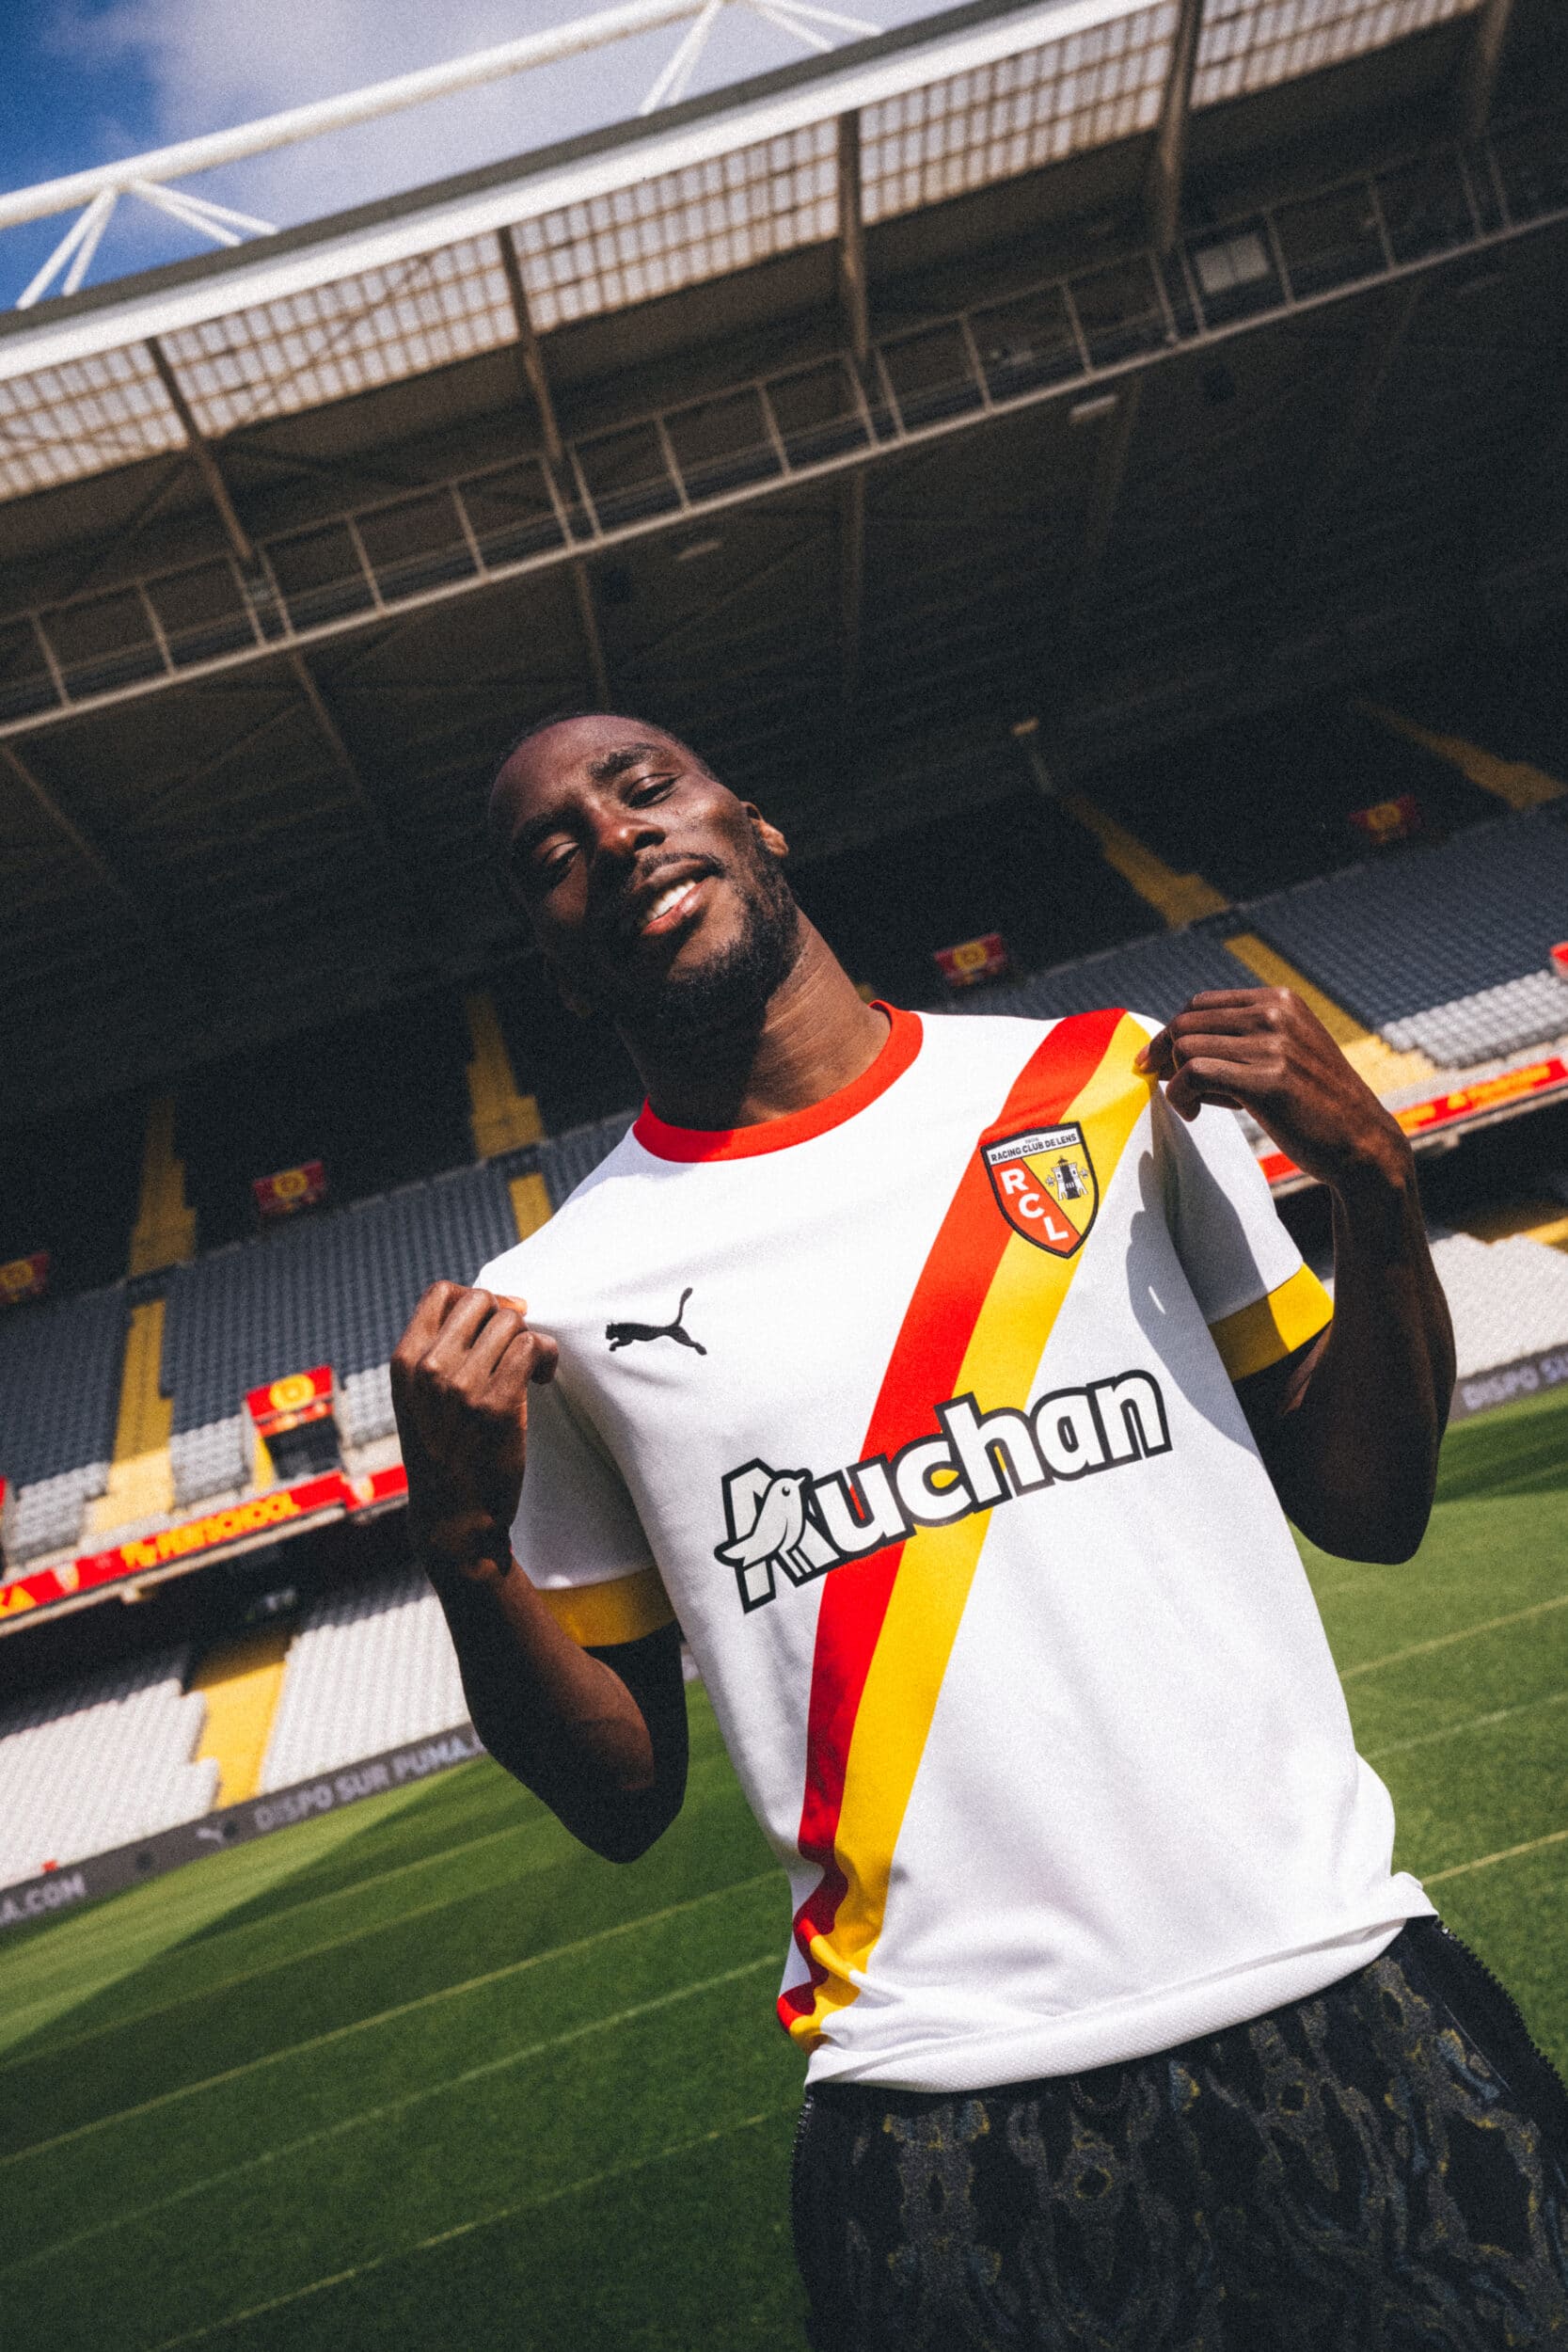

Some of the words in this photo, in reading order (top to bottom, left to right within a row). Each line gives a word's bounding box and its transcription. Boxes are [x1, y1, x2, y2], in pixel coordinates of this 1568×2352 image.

[990, 1145, 1022, 1163] RACING
[1022, 1140, 1044, 1153] CLUB
[1045, 1137, 1056, 1149] DE
[1056, 1133, 1077, 1146] LENS
[1000, 1168, 1069, 1242] RCL
[713, 1369, 1174, 1615] Auchan
